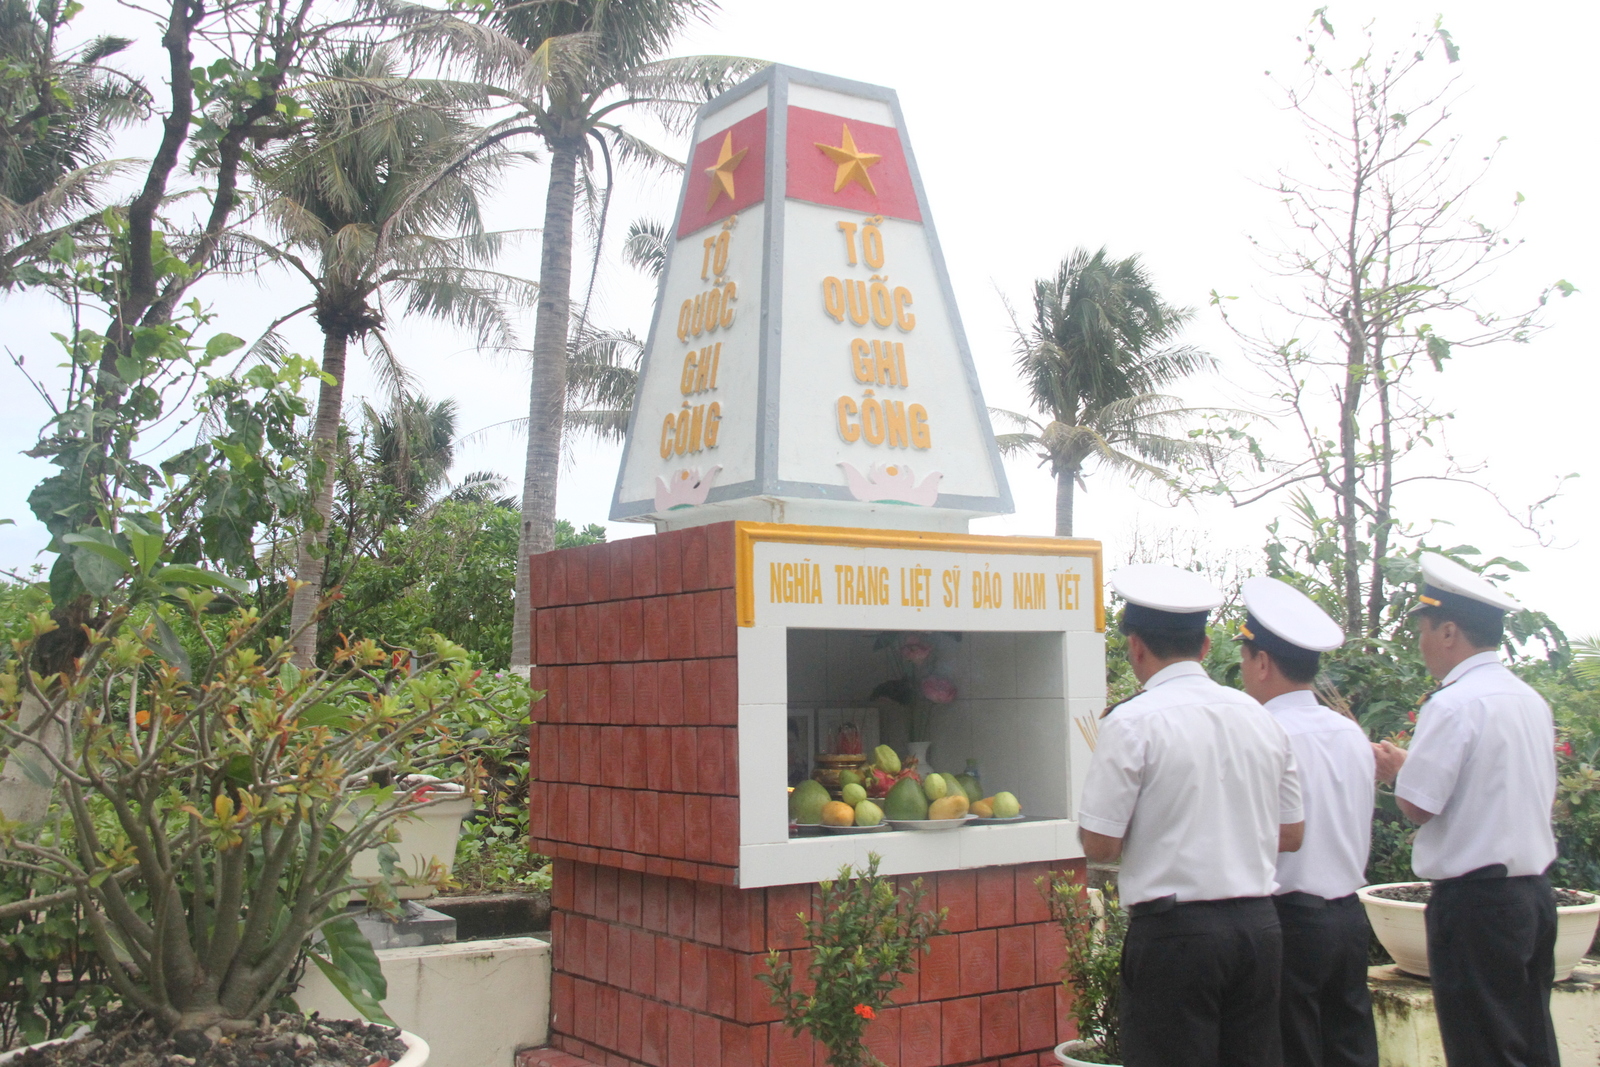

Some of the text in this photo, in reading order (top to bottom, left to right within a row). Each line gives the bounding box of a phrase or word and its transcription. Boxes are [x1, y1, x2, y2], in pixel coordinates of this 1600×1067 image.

[837, 214, 885, 269] TỔ
[821, 274, 916, 331] QUỐC
[680, 342, 722, 396] GHI
[850, 338, 909, 388] GHI
[660, 400, 722, 460] CÔNG
[836, 389, 932, 449] CÔNG
[770, 558, 1081, 612] NGHĨA TRANG LIỆT SỸ ĐẢO NAM YẾT
